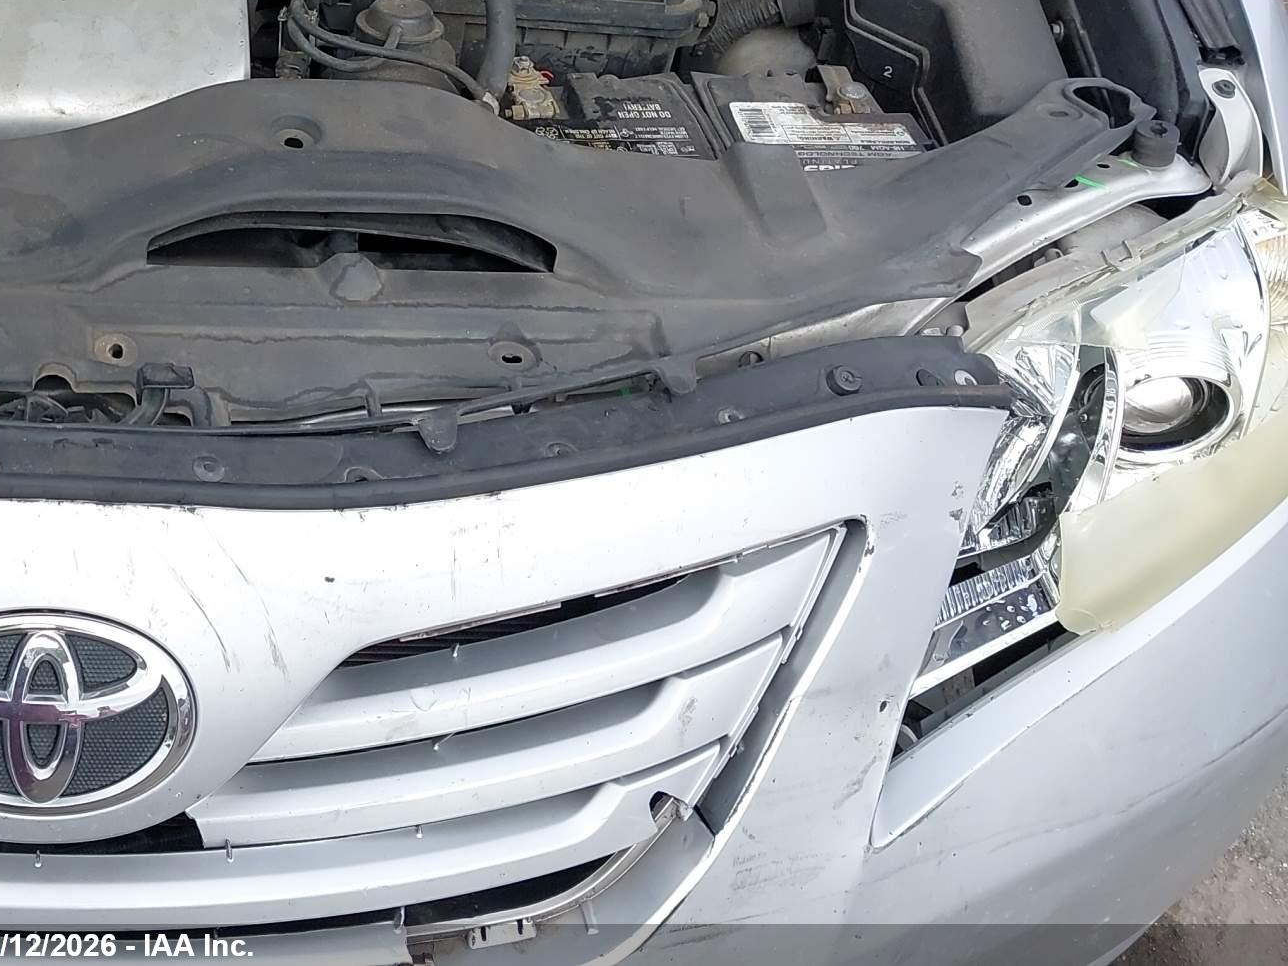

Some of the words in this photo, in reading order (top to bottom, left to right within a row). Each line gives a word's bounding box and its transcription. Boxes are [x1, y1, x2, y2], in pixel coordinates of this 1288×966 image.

[883, 65, 893, 79] 2
[617, 110, 640, 119] OPEN
[641, 110, 658, 119] NOT
[658, 110, 672, 119] DO
